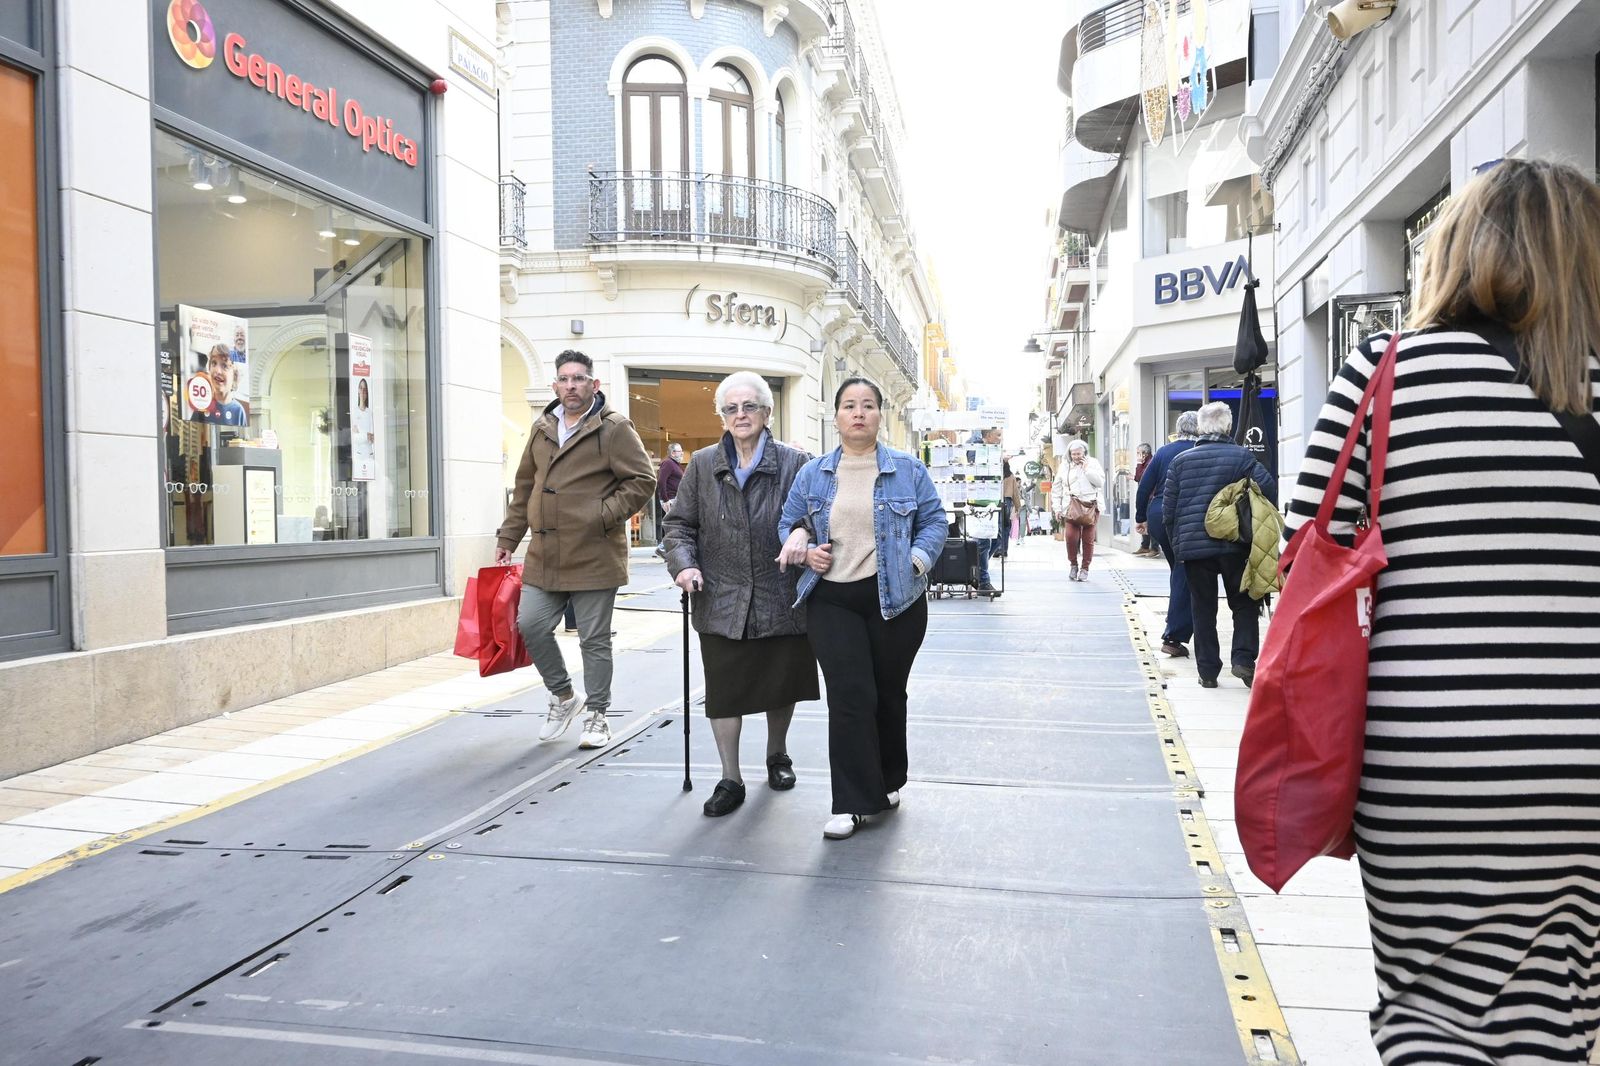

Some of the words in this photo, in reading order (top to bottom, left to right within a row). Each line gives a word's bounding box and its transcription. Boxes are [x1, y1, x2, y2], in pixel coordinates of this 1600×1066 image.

[457, 53, 489, 84] PALACIO
[223, 32, 340, 127] General
[344, 98, 418, 167] Optica
[1154, 254, 1256, 305] BBVA
[192, 385, 207, 398] 50
